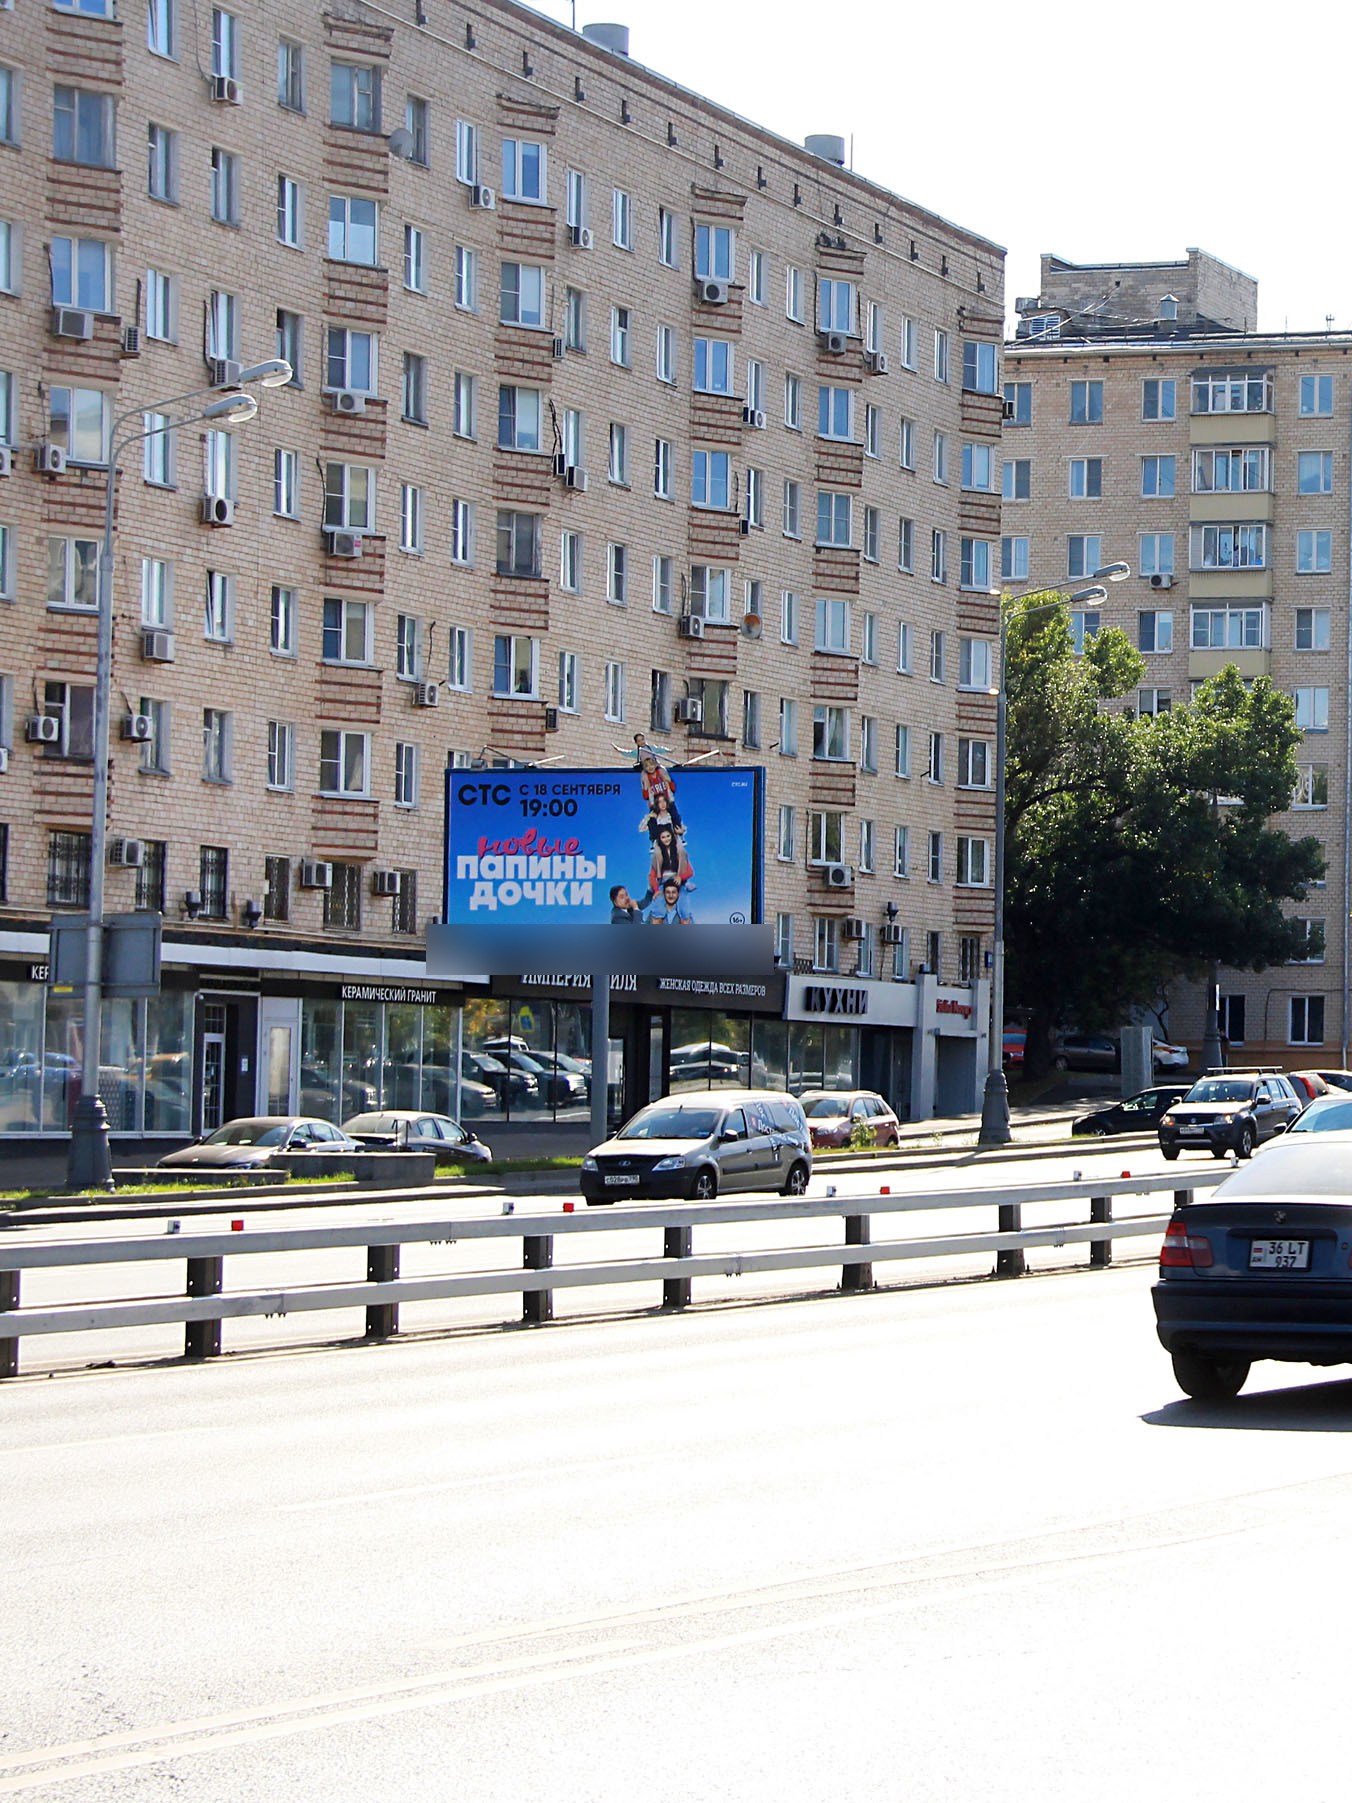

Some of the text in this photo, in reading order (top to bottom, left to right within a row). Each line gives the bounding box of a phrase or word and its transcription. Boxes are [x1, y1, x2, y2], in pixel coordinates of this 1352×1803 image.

[534, 784, 547, 796] 18
[552, 784, 621, 796] СЕНТЯБРЯ
[520, 799, 578, 817] 19:00
[478, 828, 583, 859] новые
[342, 985, 437, 1004] КЕРАМИЧЕСКИЙ ГРАНИТ
[659, 977, 766, 997] ЖЕНСКАЯ ОДЕЖДА ВСЕХ РАЗМЕРОВ
[808, 986, 868, 1015] КУХНИ
[1269, 1242, 1306, 1255] 36 LT
